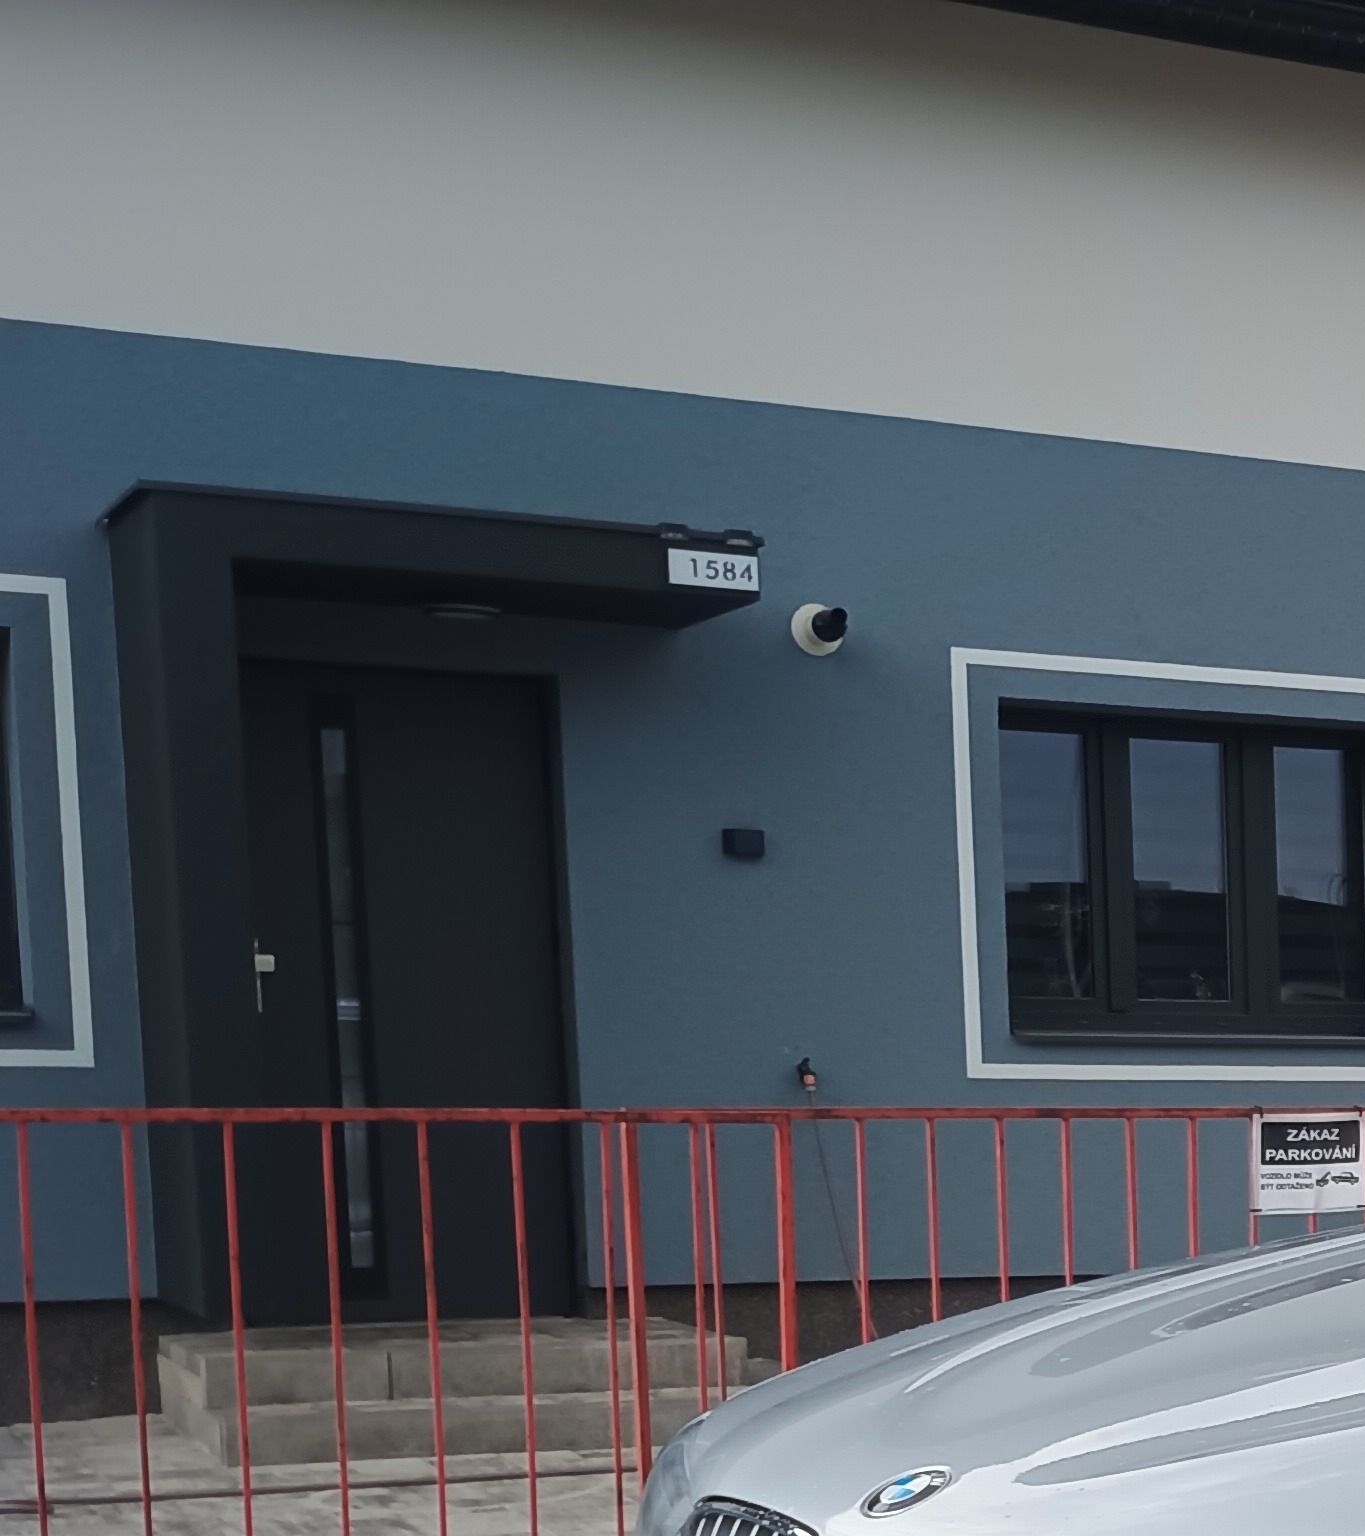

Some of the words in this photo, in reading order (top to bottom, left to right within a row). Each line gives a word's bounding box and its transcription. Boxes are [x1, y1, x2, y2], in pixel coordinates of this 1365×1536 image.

[689, 557, 753, 582] 1584
[1286, 1126, 1340, 1141] ZÁKAZ
[1265, 1143, 1356, 1161] PARKOVÁNÍ
